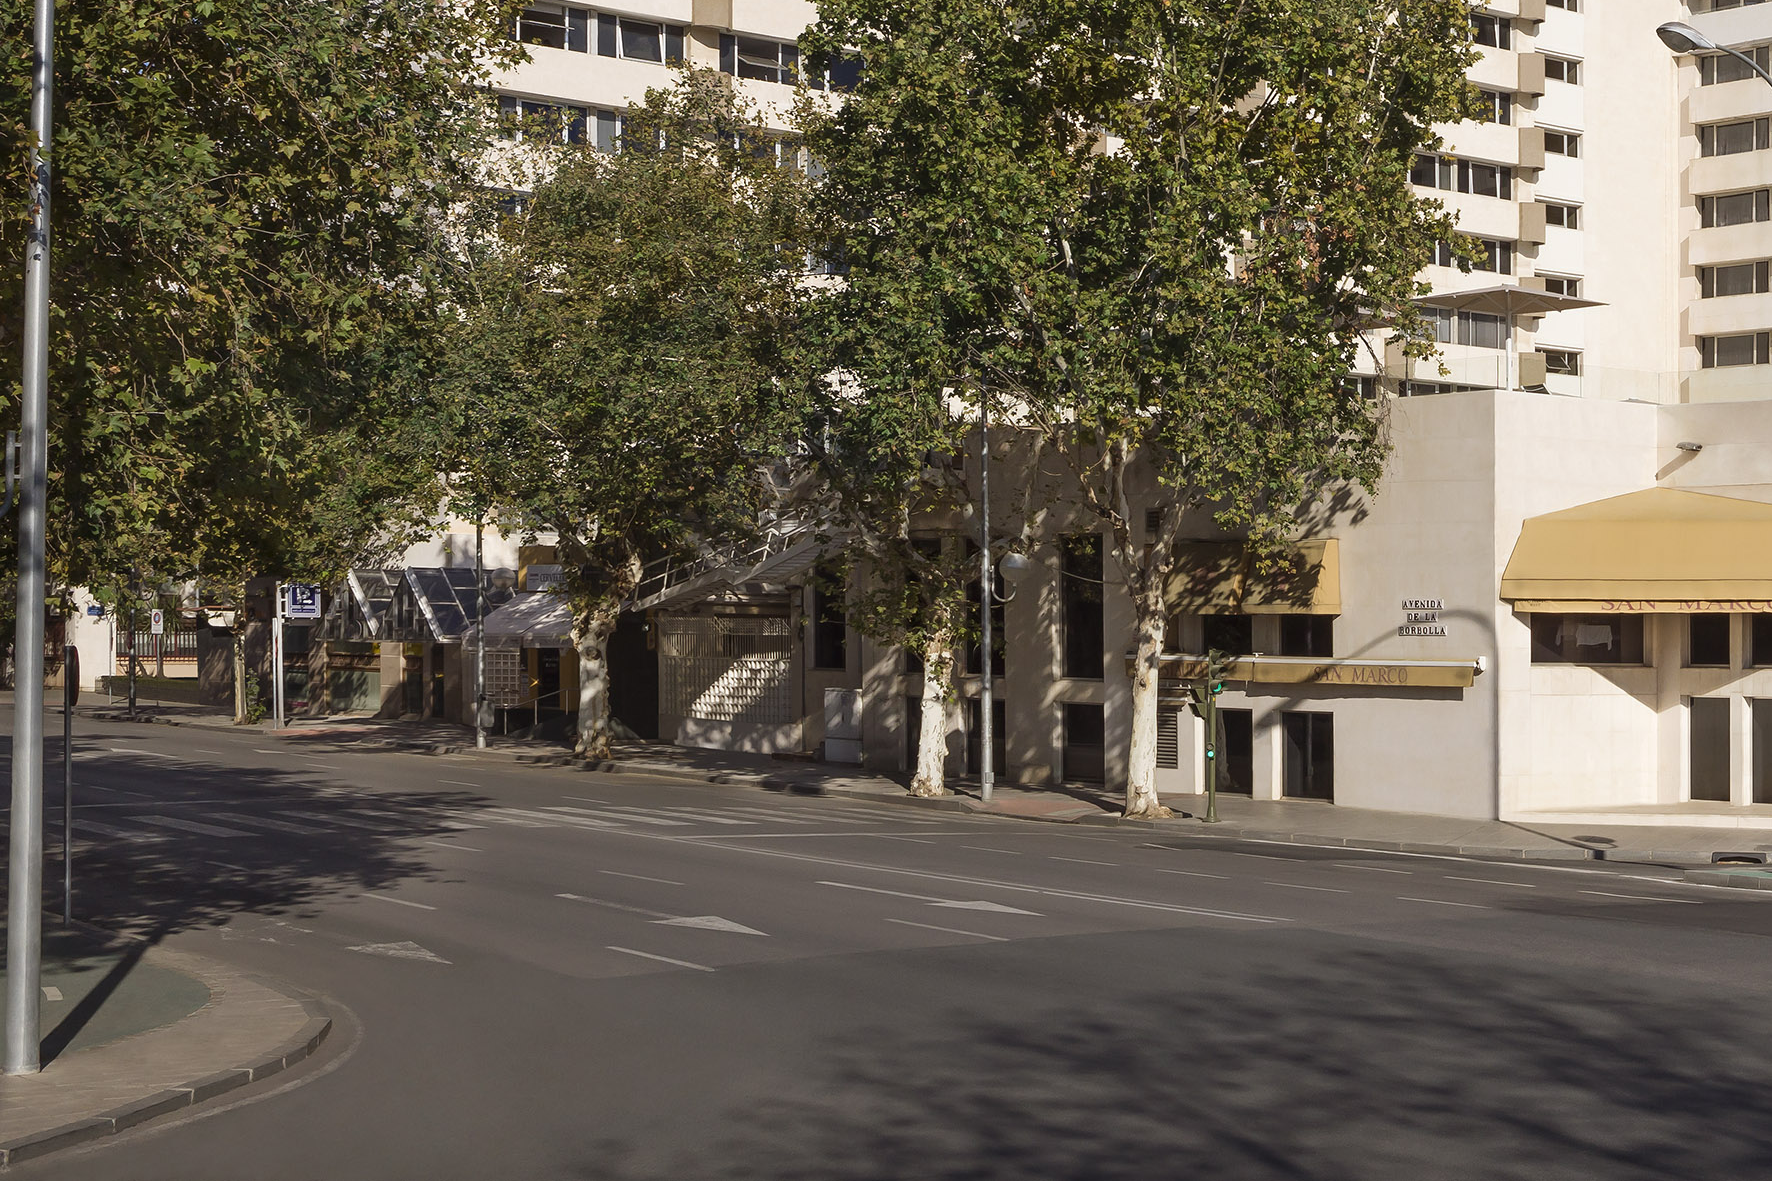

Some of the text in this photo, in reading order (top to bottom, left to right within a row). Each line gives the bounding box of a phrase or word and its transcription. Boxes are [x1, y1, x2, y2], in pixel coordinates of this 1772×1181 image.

[1402, 600, 1443, 608] AVENIDA
[1399, 626, 1446, 635] BORBOLLA
[1313, 666, 1408, 684] SAN MARCO
